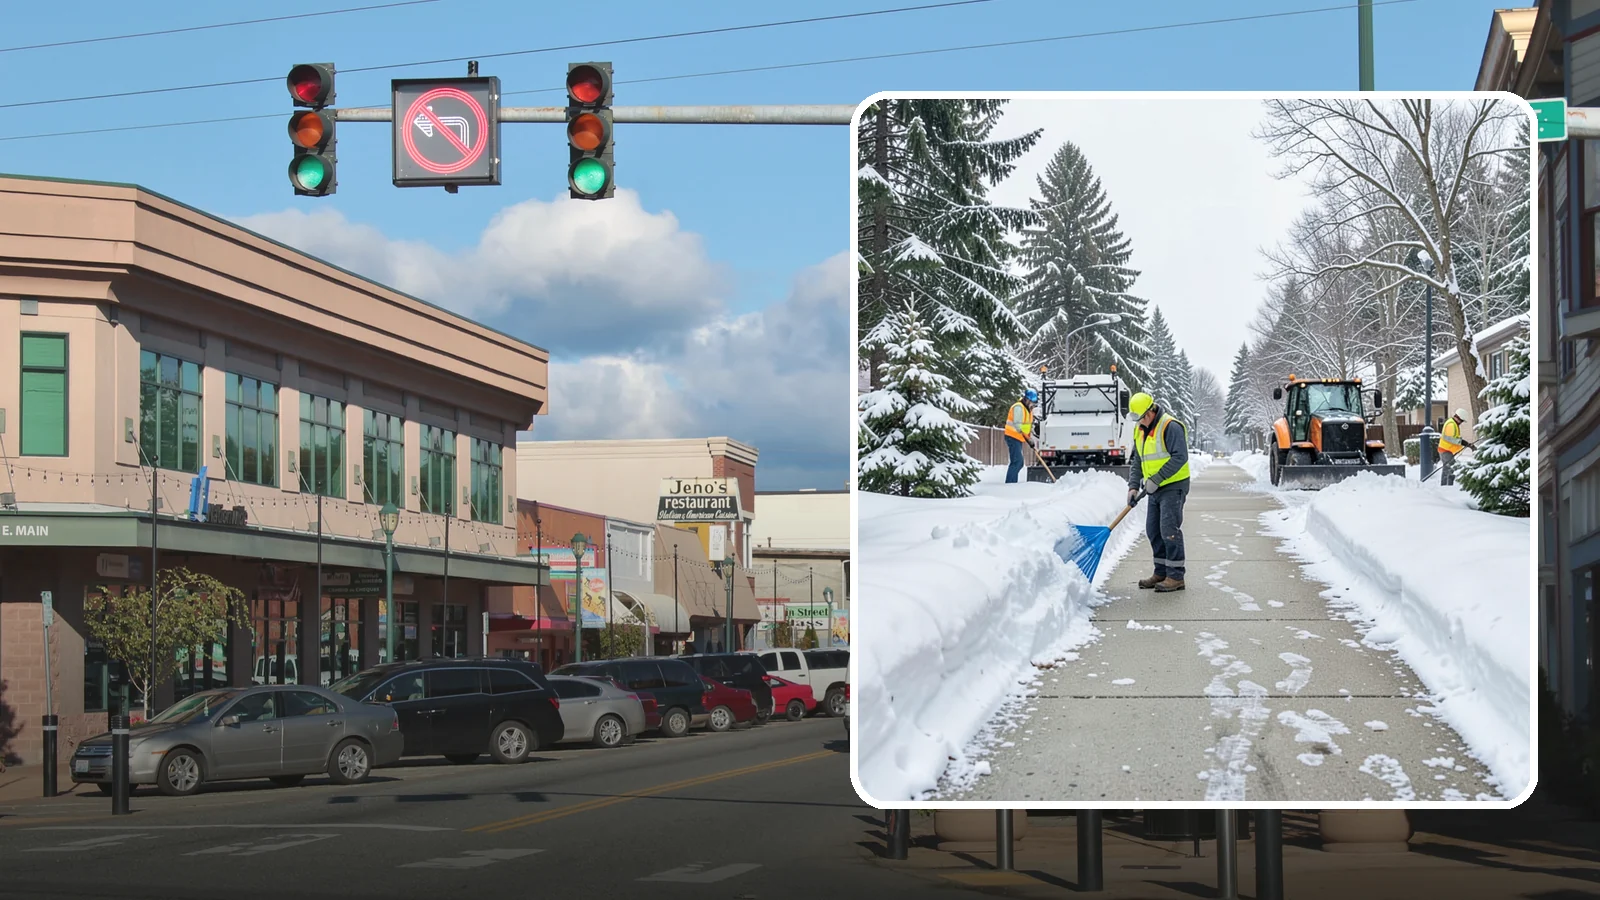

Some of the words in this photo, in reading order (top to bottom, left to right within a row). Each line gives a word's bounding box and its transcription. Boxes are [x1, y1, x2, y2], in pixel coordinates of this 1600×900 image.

[669, 480, 727, 495] Jeno's
[665, 496, 731, 509] restaurant
[658, 510, 682, 519] Italian
[685, 509, 715, 519] American
[714, 509, 737, 519] Cuisine
[2, 525, 13, 536] E.
[15, 525, 49, 536] MAIN
[797, 607, 828, 617] Street
